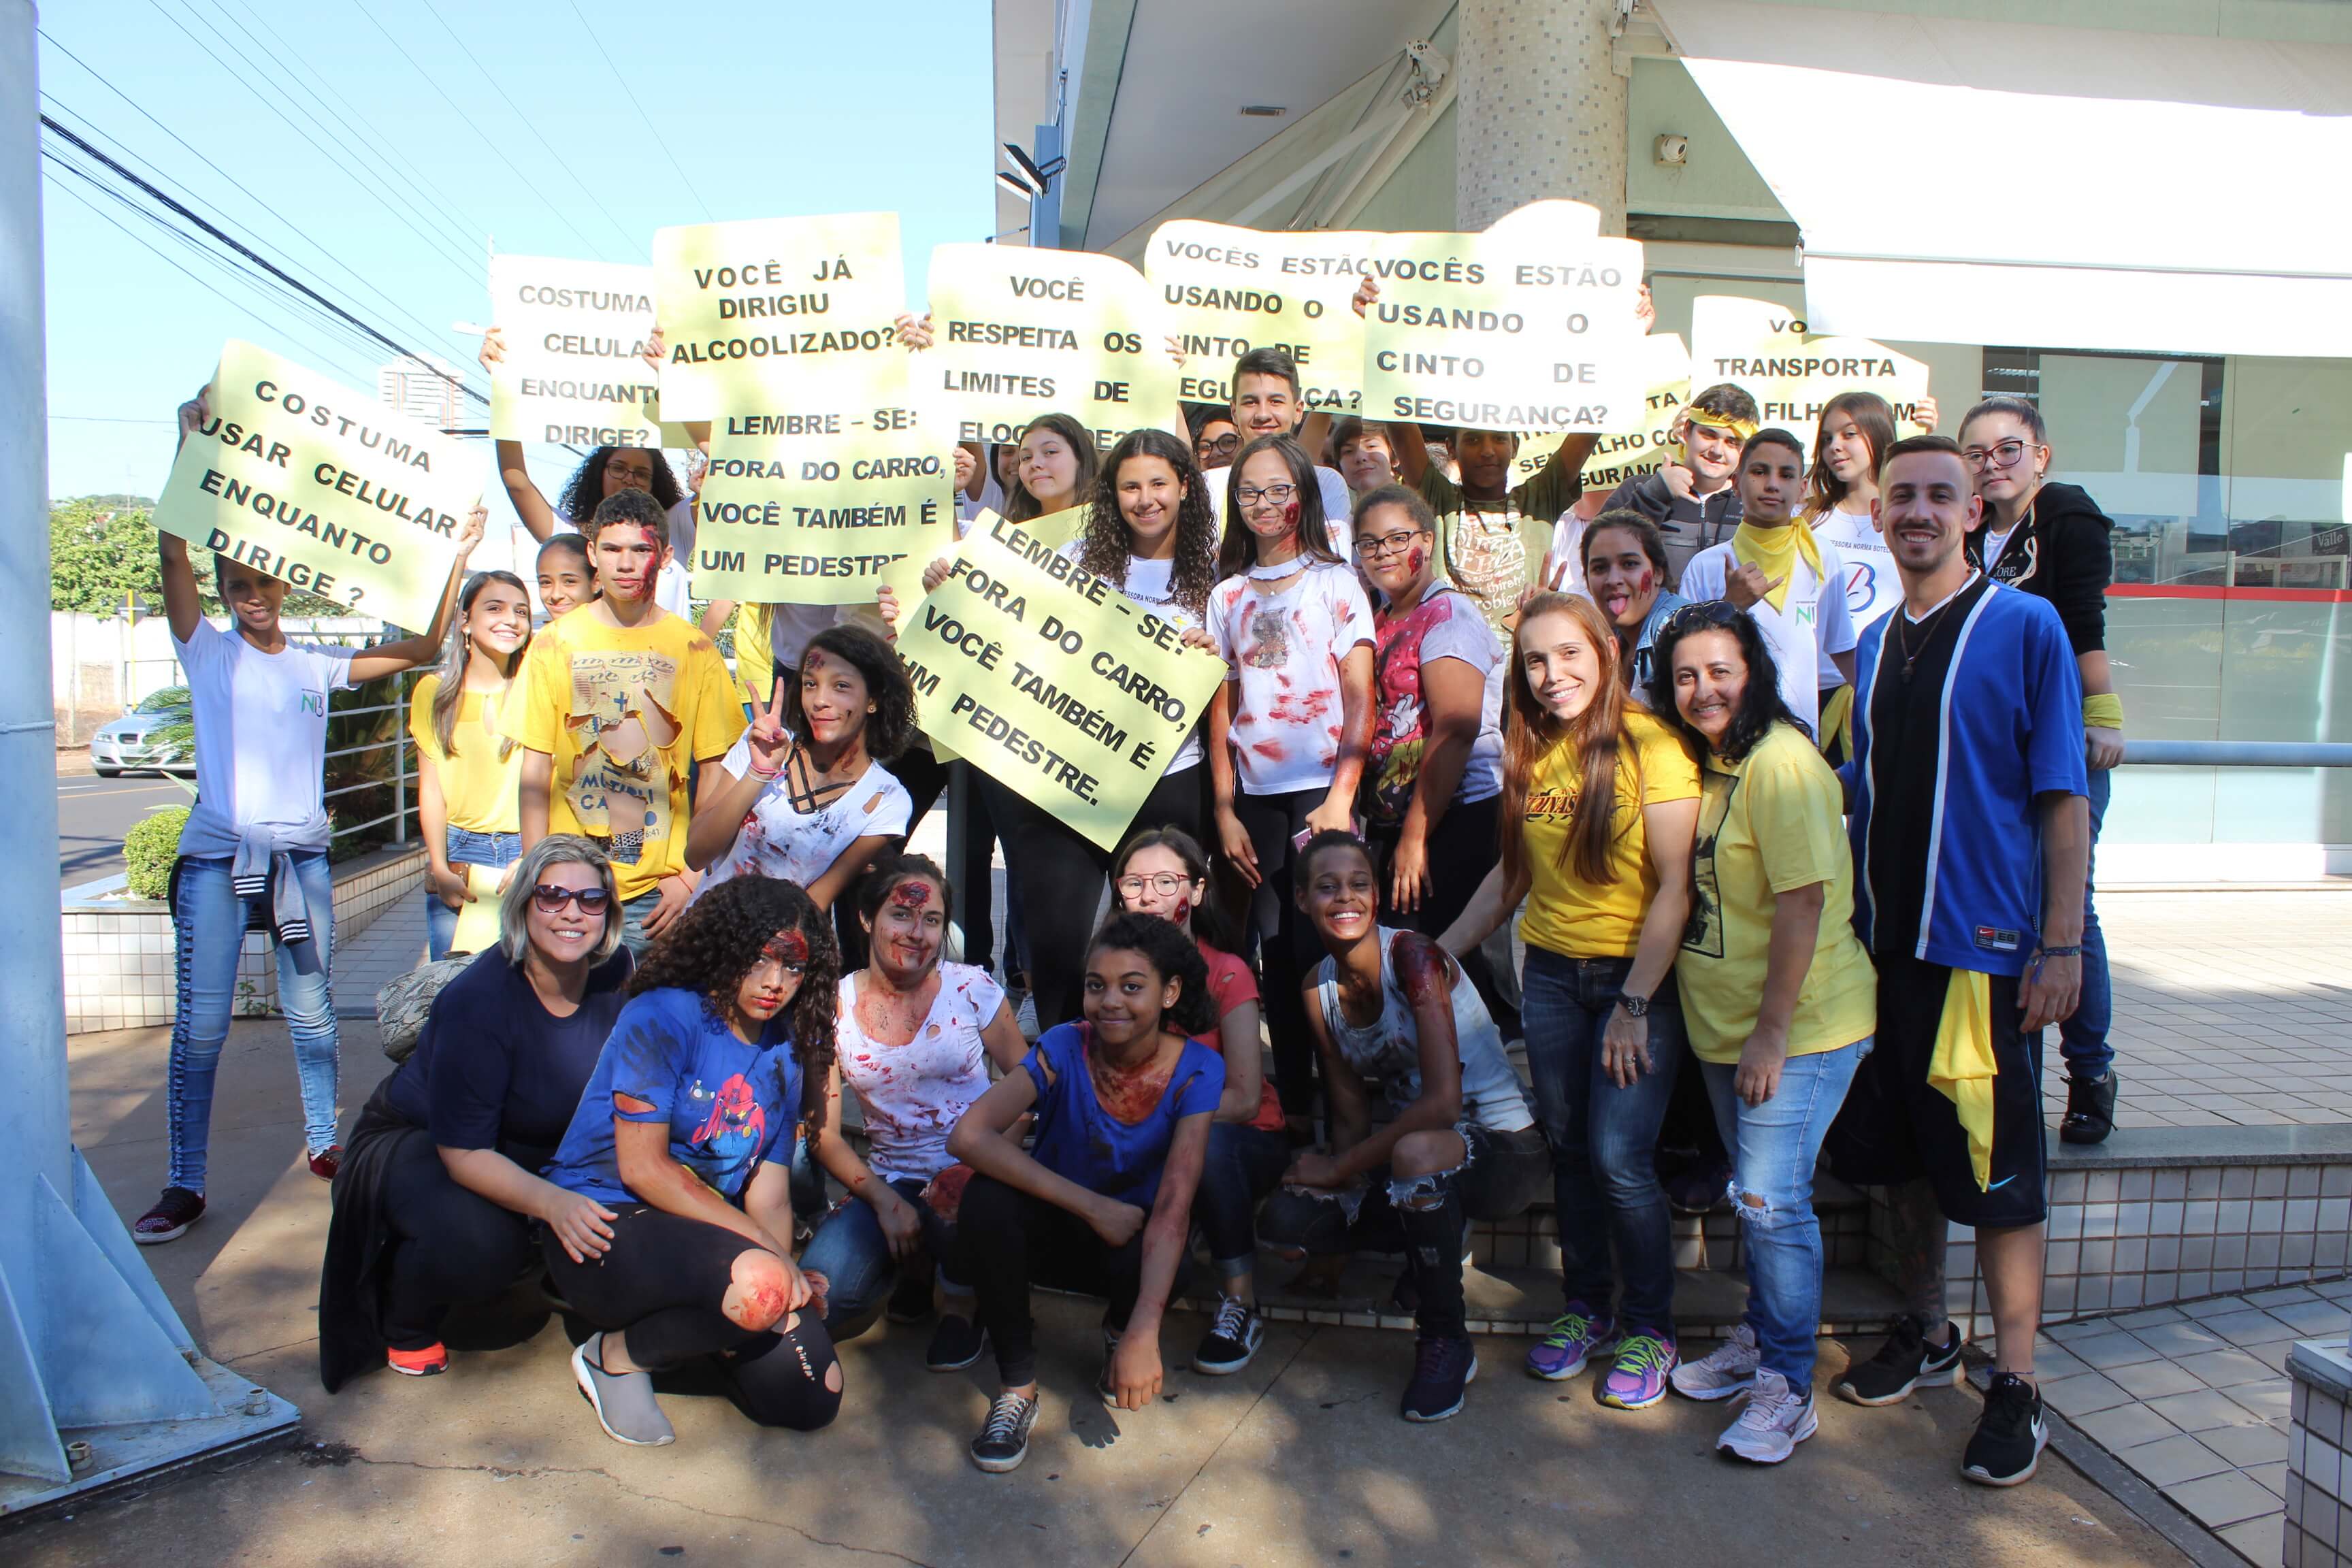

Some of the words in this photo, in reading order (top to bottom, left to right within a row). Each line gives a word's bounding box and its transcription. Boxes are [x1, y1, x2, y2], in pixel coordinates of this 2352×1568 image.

[1166, 240, 1259, 269] VOCÊS
[694, 259, 782, 289] VOCÊ
[813, 255, 852, 282] JÁ
[1375, 257, 1484, 284] VOCÊS
[1516, 263, 1622, 287] ESTÃO
[519, 285, 652, 313] COSTUMA
[1009, 276, 1084, 301] VOCÊ
[1164, 284, 1283, 314] USANDO
[1303, 300, 1323, 318] O
[719, 293, 830, 319] DIRIGIU
[1379, 303, 1524, 333] USANDO
[1567, 314, 1588, 333] O
[949, 321, 1078, 350] RESPEITA
[1104, 332, 1142, 354] OS
[1769, 320, 1808, 333] VO
[544, 333, 644, 358] CELULA
[671, 327, 896, 364] ALCOOLIZADO?
[1177, 334, 1250, 358] INTO
[1377, 351, 1484, 377] CINTO
[1554, 363, 1596, 383] DE
[1714, 359, 1896, 376] TRANSPORTA
[521, 378, 659, 403] ENQUANT
[944, 370, 1056, 397] LIMITES
[1094, 381, 1129, 402] DE
[256, 380, 430, 472] COSTUMA
[728, 414, 840, 435] LEMBRE
[873, 409, 916, 431] SE:
[1394, 396, 1607, 430] SEGURANÇA?
[1764, 403, 1823, 421] FILH
[545, 424, 649, 447] DIRIGE?
[1652, 429, 1679, 446] CO
[709, 459, 785, 479] FORA
[802, 461, 840, 481] DO
[853, 456, 945, 480] CARRO,
[1519, 453, 1552, 472] SE
[200, 417, 291, 468] USAR
[314, 463, 457, 538] CELULAR
[199, 469, 392, 565] ENQUANTO
[703, 501, 780, 525] VOCÊ
[792, 502, 905, 528] TAMBÉM
[921, 498, 936, 524] É
[701, 550, 745, 572] UM
[764, 554, 908, 576] PEDESTR
[1873, 545, 1891, 553] BOTEL
[990, 517, 1109, 606] LEMBRE
[1137, 614, 1186, 655] SE:
[949, 557, 1027, 622] FORA
[1039, 616, 1083, 654] DO
[1091, 652, 1186, 733] CARRO,
[924, 604, 1004, 671] VOCÊ
[1011, 662, 1127, 753] TAMBÉM
[1130, 741, 1156, 770] É
[950, 693, 1100, 806] PEDESTRE.
